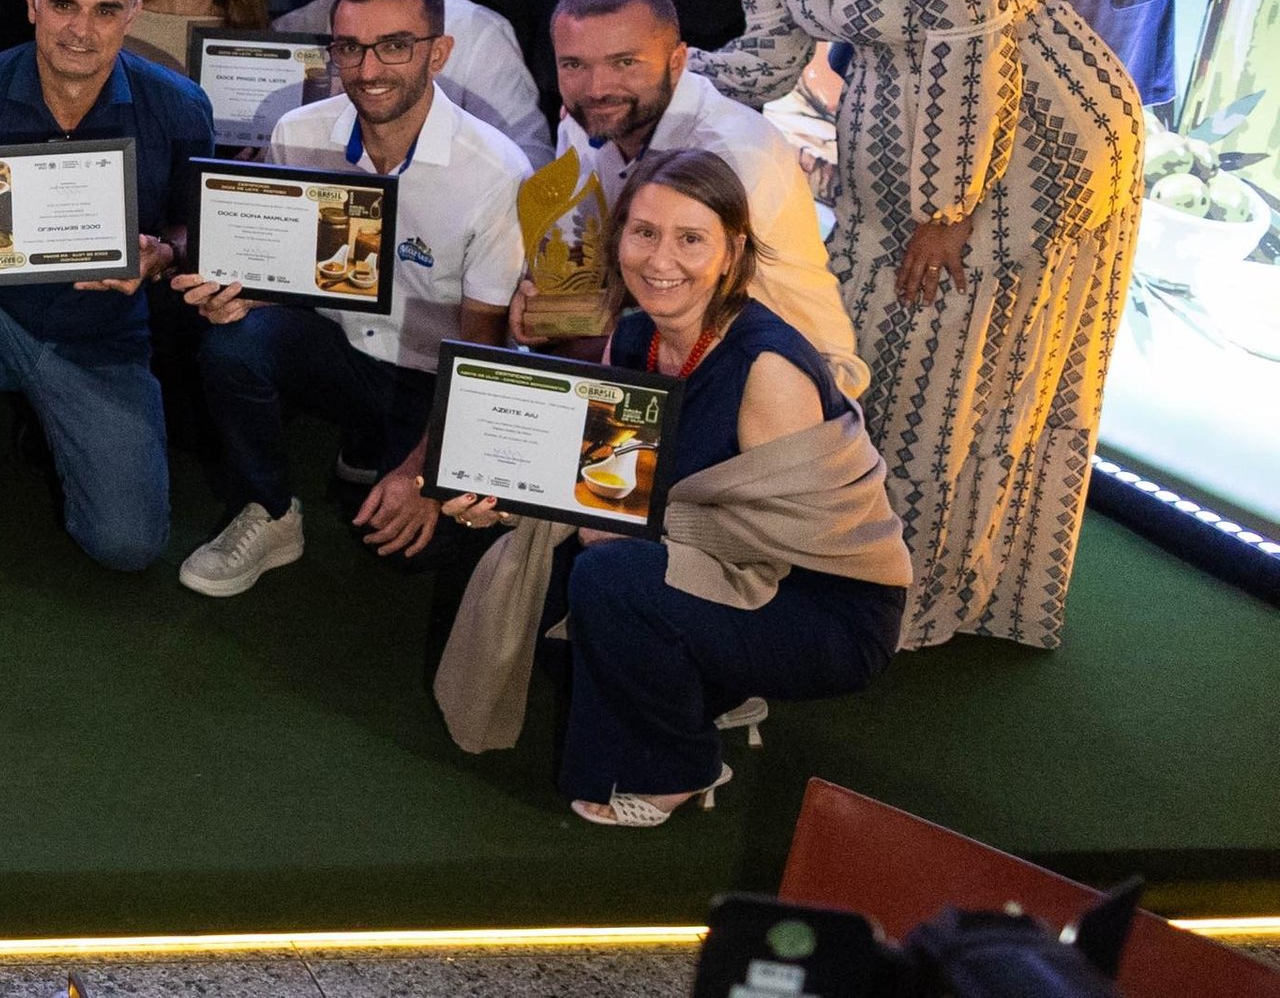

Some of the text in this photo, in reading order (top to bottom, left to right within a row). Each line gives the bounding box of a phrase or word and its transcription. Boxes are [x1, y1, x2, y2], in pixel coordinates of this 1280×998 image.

[263, 214, 300, 223] MARLENE
[37, 224, 79, 232] SERTANEJO
[588, 387, 617, 399] BRASIL
[492, 406, 522, 416] AZEITE
